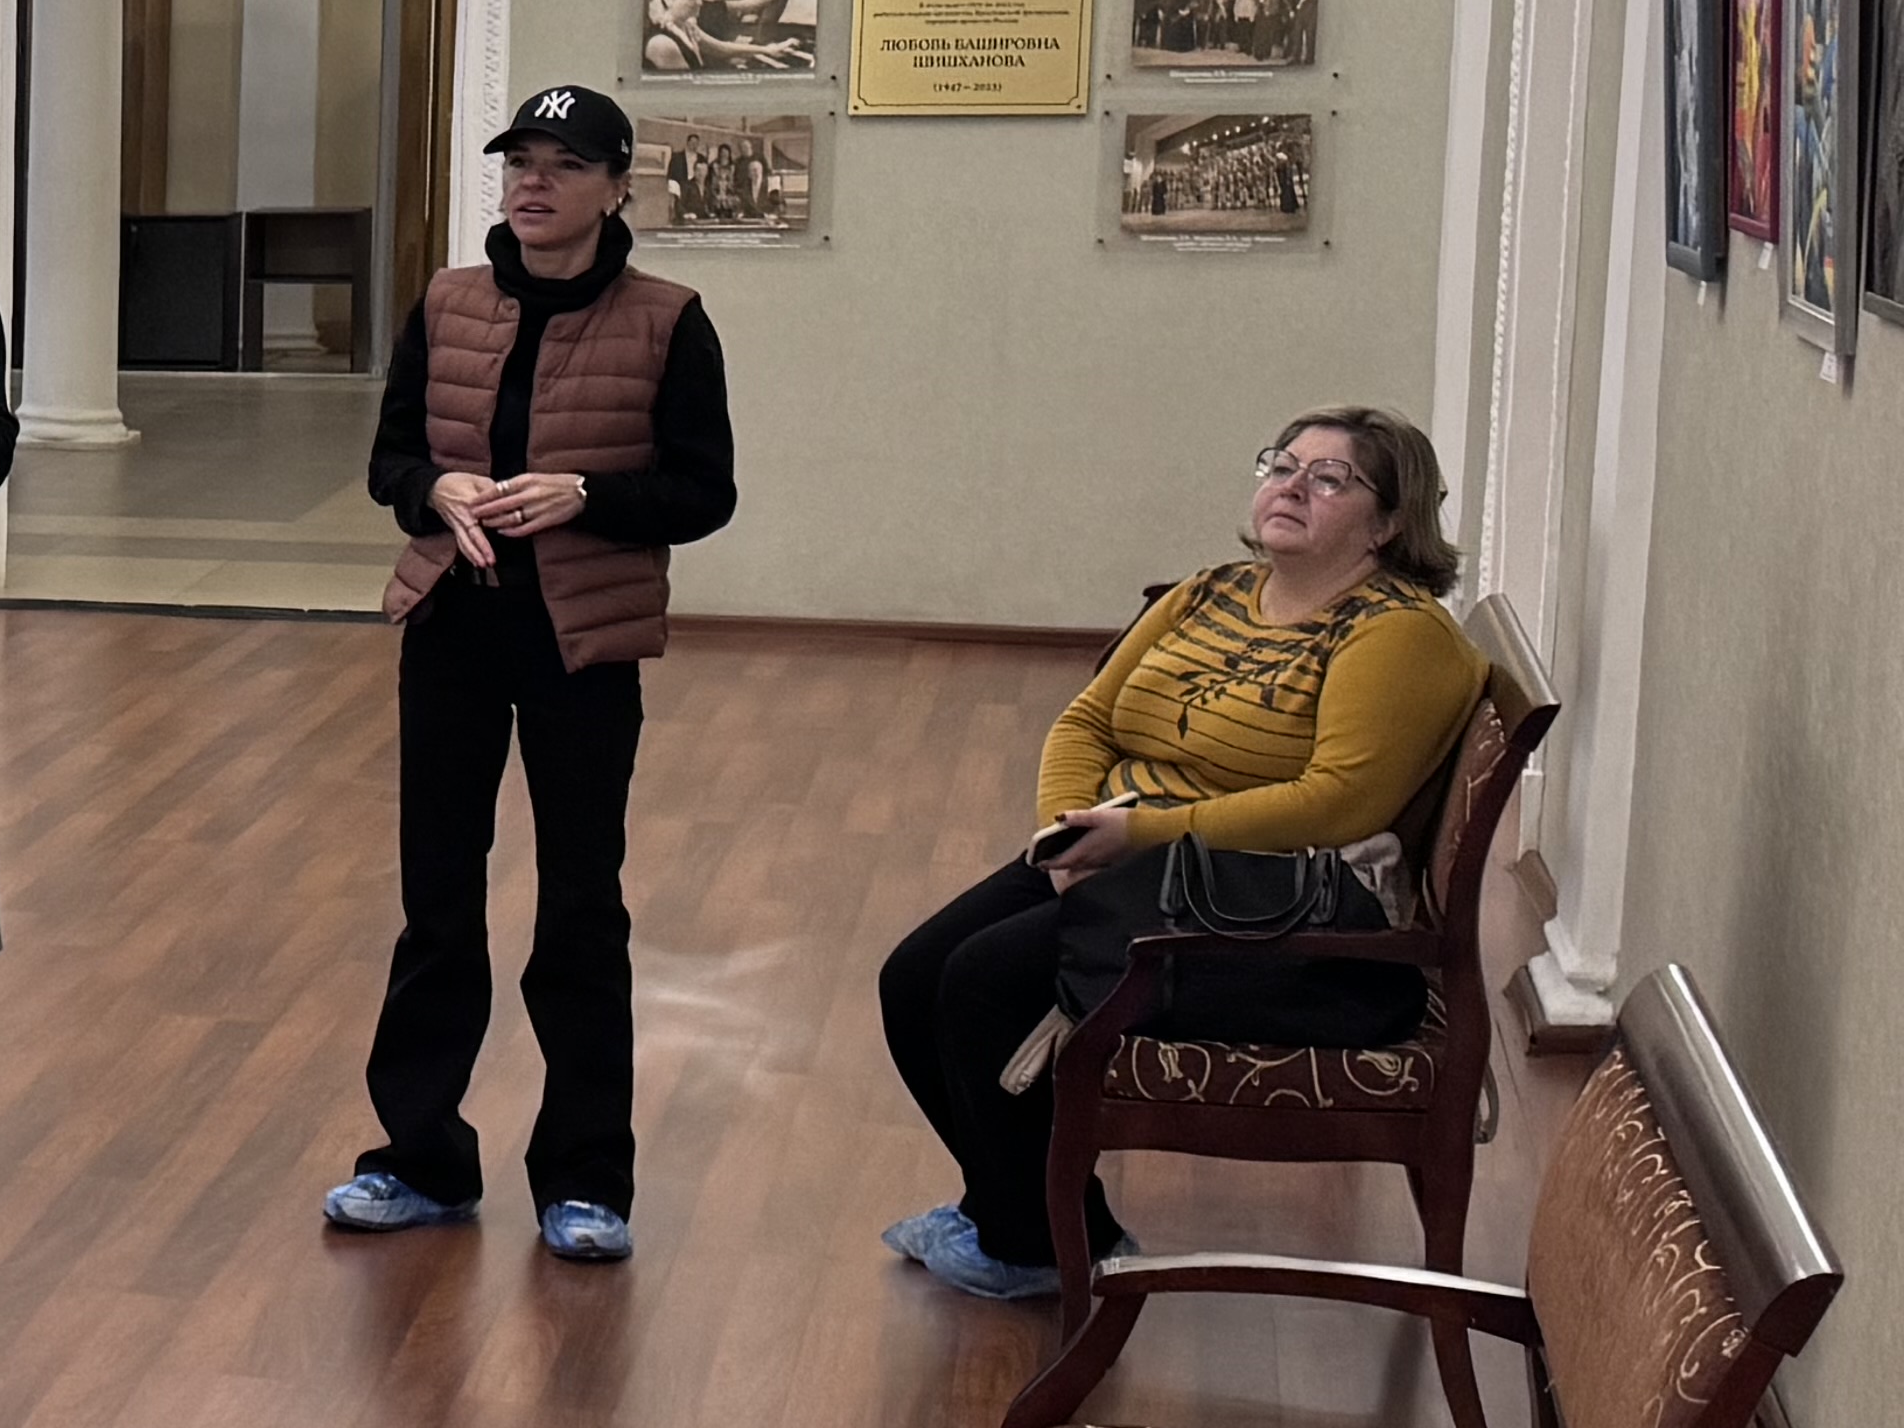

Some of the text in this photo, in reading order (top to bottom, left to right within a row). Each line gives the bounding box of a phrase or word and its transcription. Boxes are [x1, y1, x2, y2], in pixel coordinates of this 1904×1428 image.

[880, 38, 951, 52] ЛЮБОВЬ
[912, 55, 1026, 69] ШИШХАНОВА
[534, 90, 576, 119] NY
